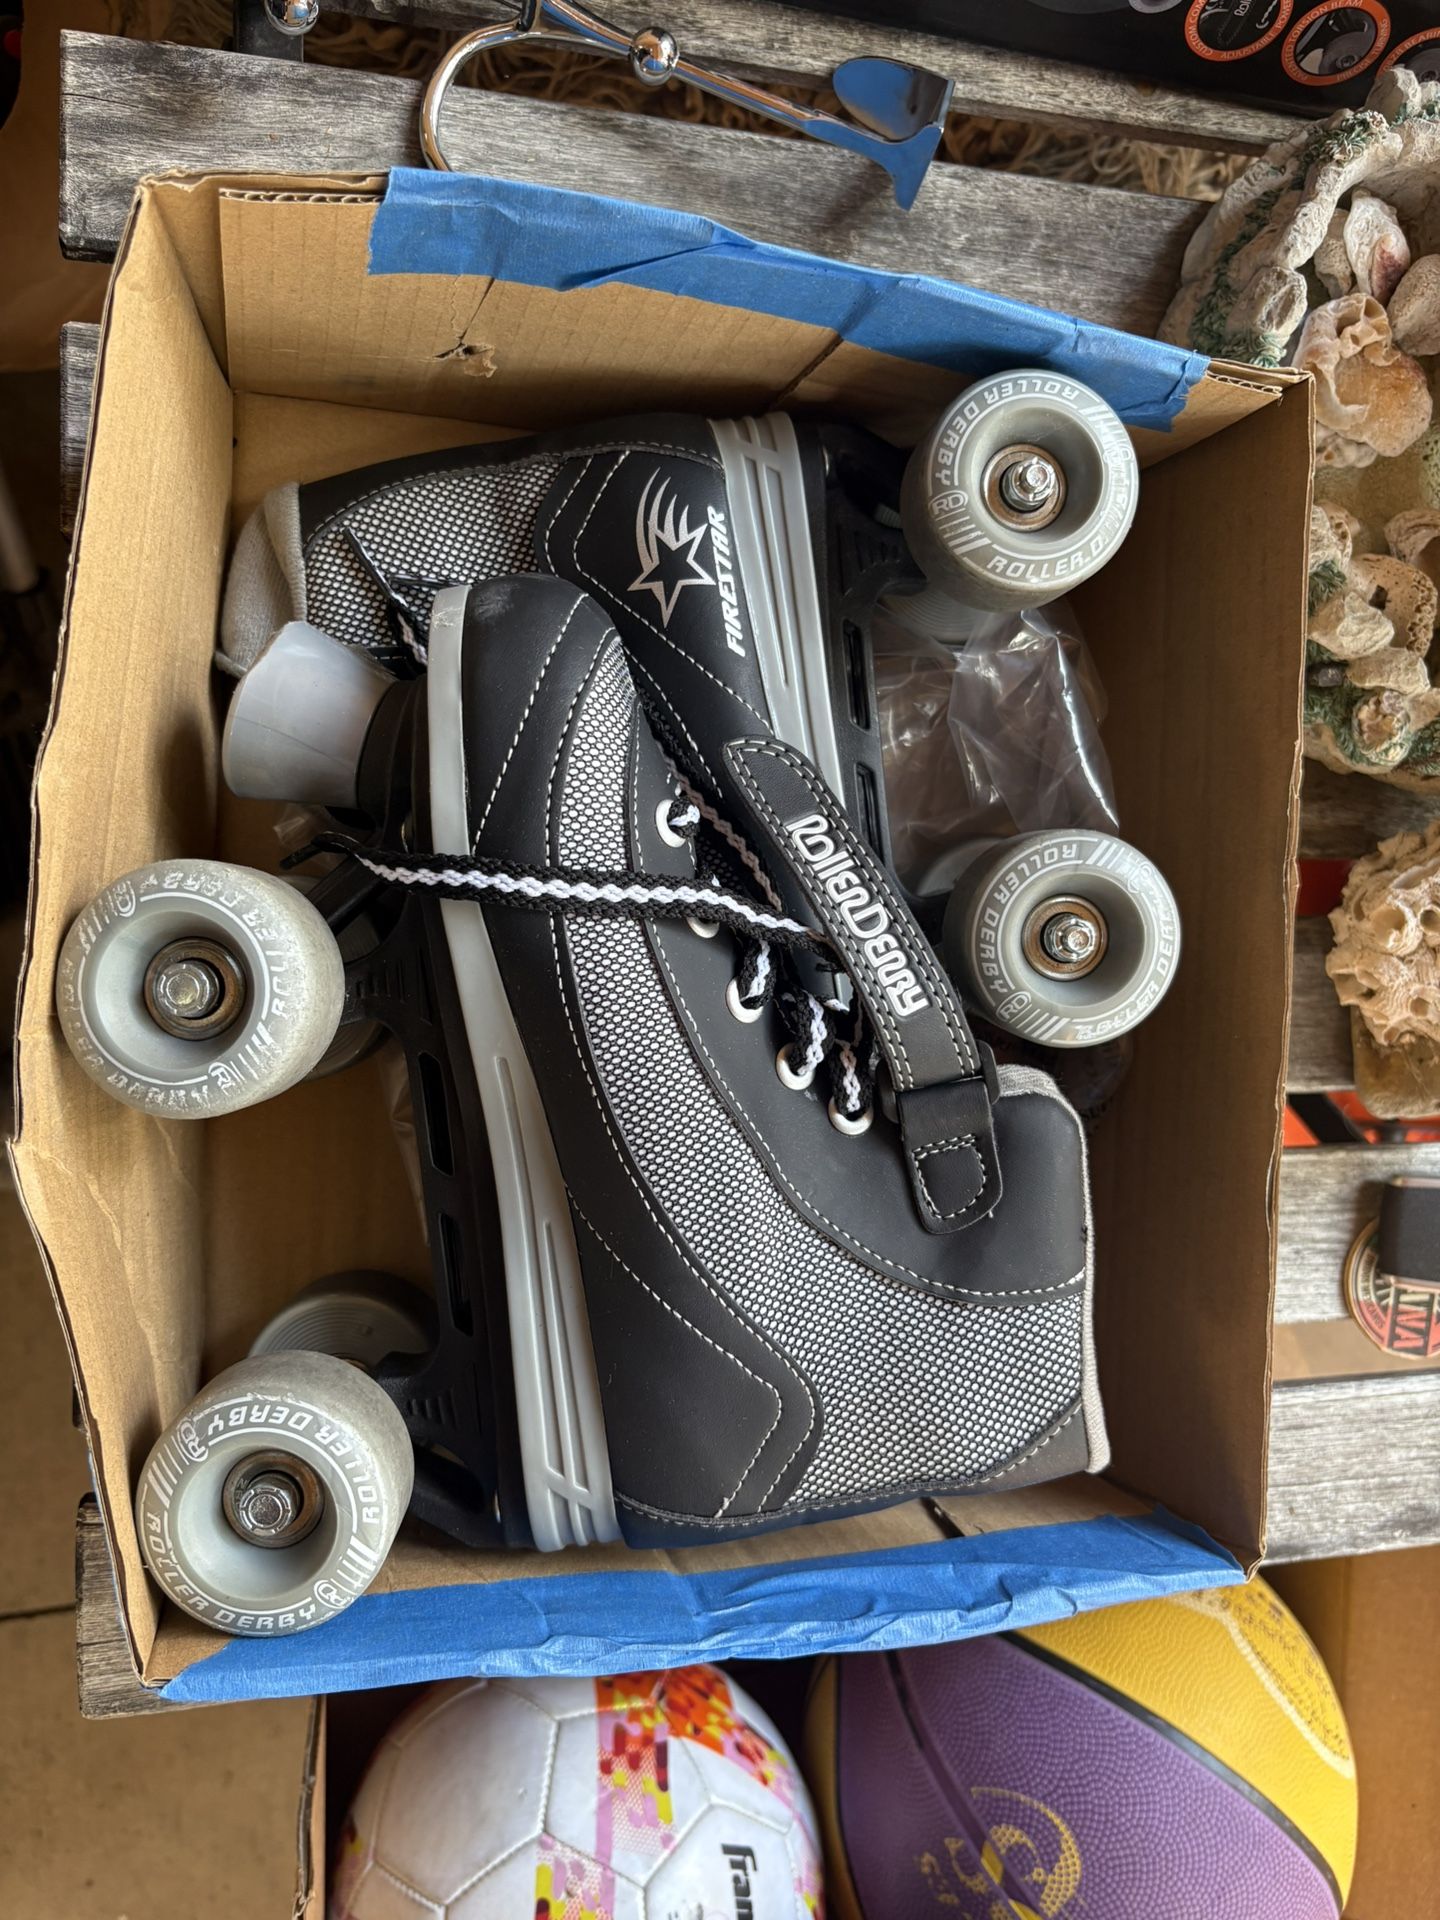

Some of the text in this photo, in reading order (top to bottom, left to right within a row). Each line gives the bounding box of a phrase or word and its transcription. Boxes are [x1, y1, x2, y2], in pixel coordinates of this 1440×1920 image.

[1189, 26, 1213, 56] CUSTOM
[935, 379, 1079, 486] ROLLER DERBY
[707, 505, 746, 658] FIRESTAR
[986, 551, 1087, 580] ROLLER
[980, 844, 1077, 993] ROLLER DERBY
[997, 996, 1030, 1020] RD
[208, 1404, 314, 1436] DERBY
[315, 1424, 381, 1524] ROLLER
[147, 1511, 317, 1630] ROLLER DERBY
